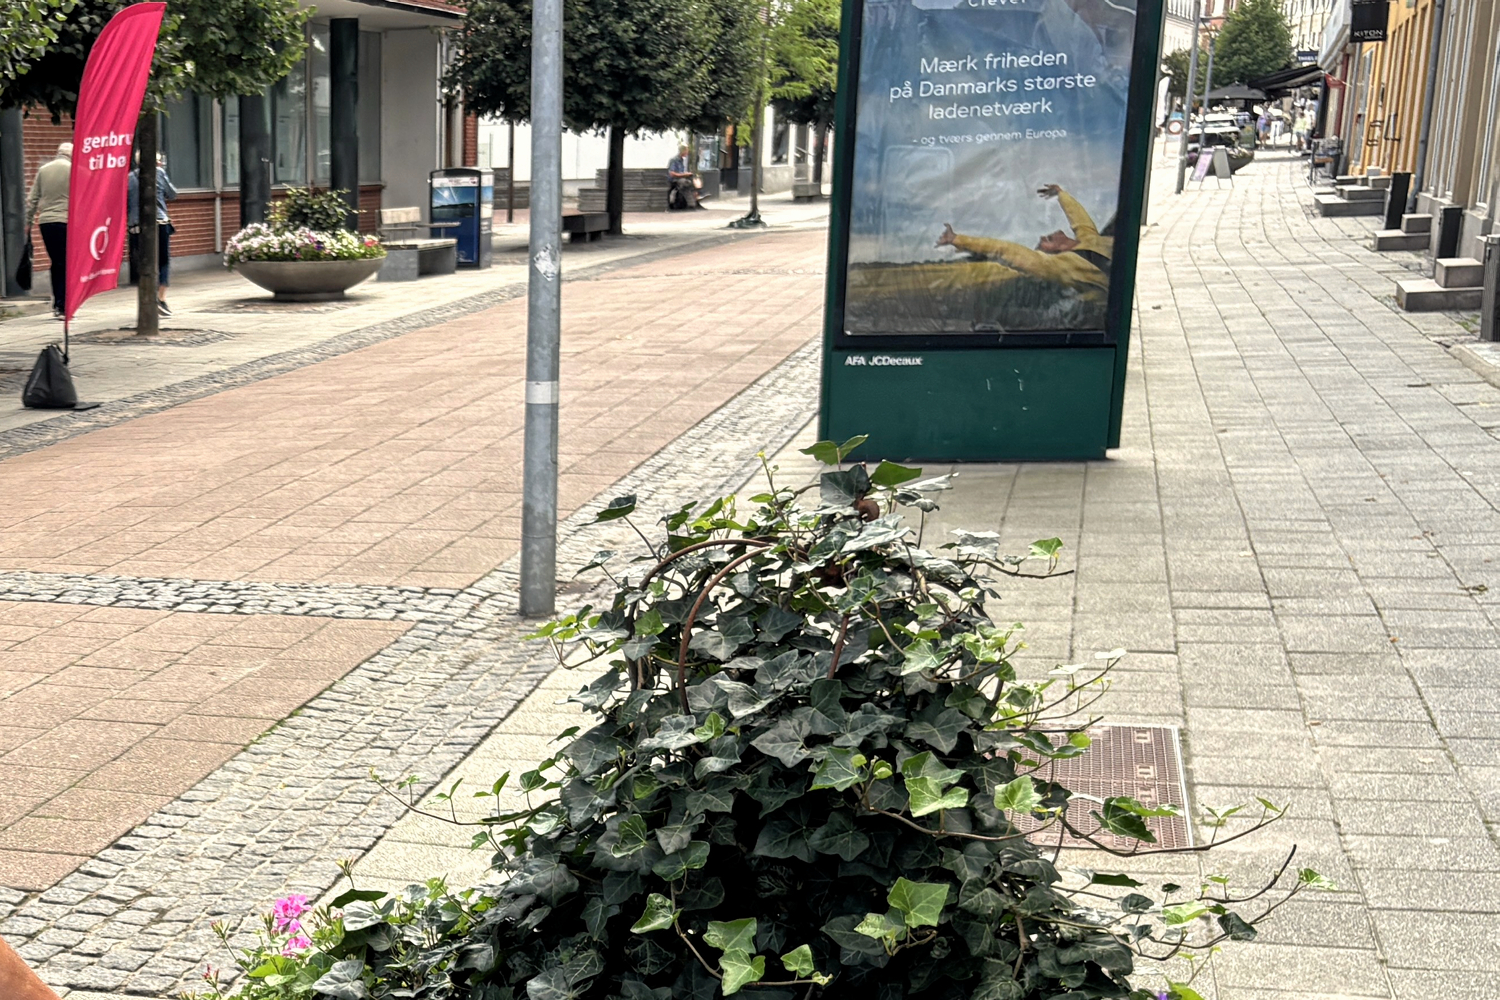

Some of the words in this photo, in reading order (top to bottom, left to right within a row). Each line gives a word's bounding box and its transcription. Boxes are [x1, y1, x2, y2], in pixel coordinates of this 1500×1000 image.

[920, 55, 978, 73] Mærk
[984, 51, 1068, 69] friheden
[889, 81, 913, 102] på
[919, 77, 1018, 97] Danmarks
[1024, 73, 1097, 91] største
[928, 97, 1053, 119] ladenetværk
[82, 131, 131, 154] genbru
[920, 136, 935, 147] og
[938, 133, 973, 144] tværs
[975, 130, 1022, 145] gennem
[1025, 128, 1067, 141] Europa
[844, 355, 867, 366] AFA
[868, 355, 924, 366] JCDecaux
